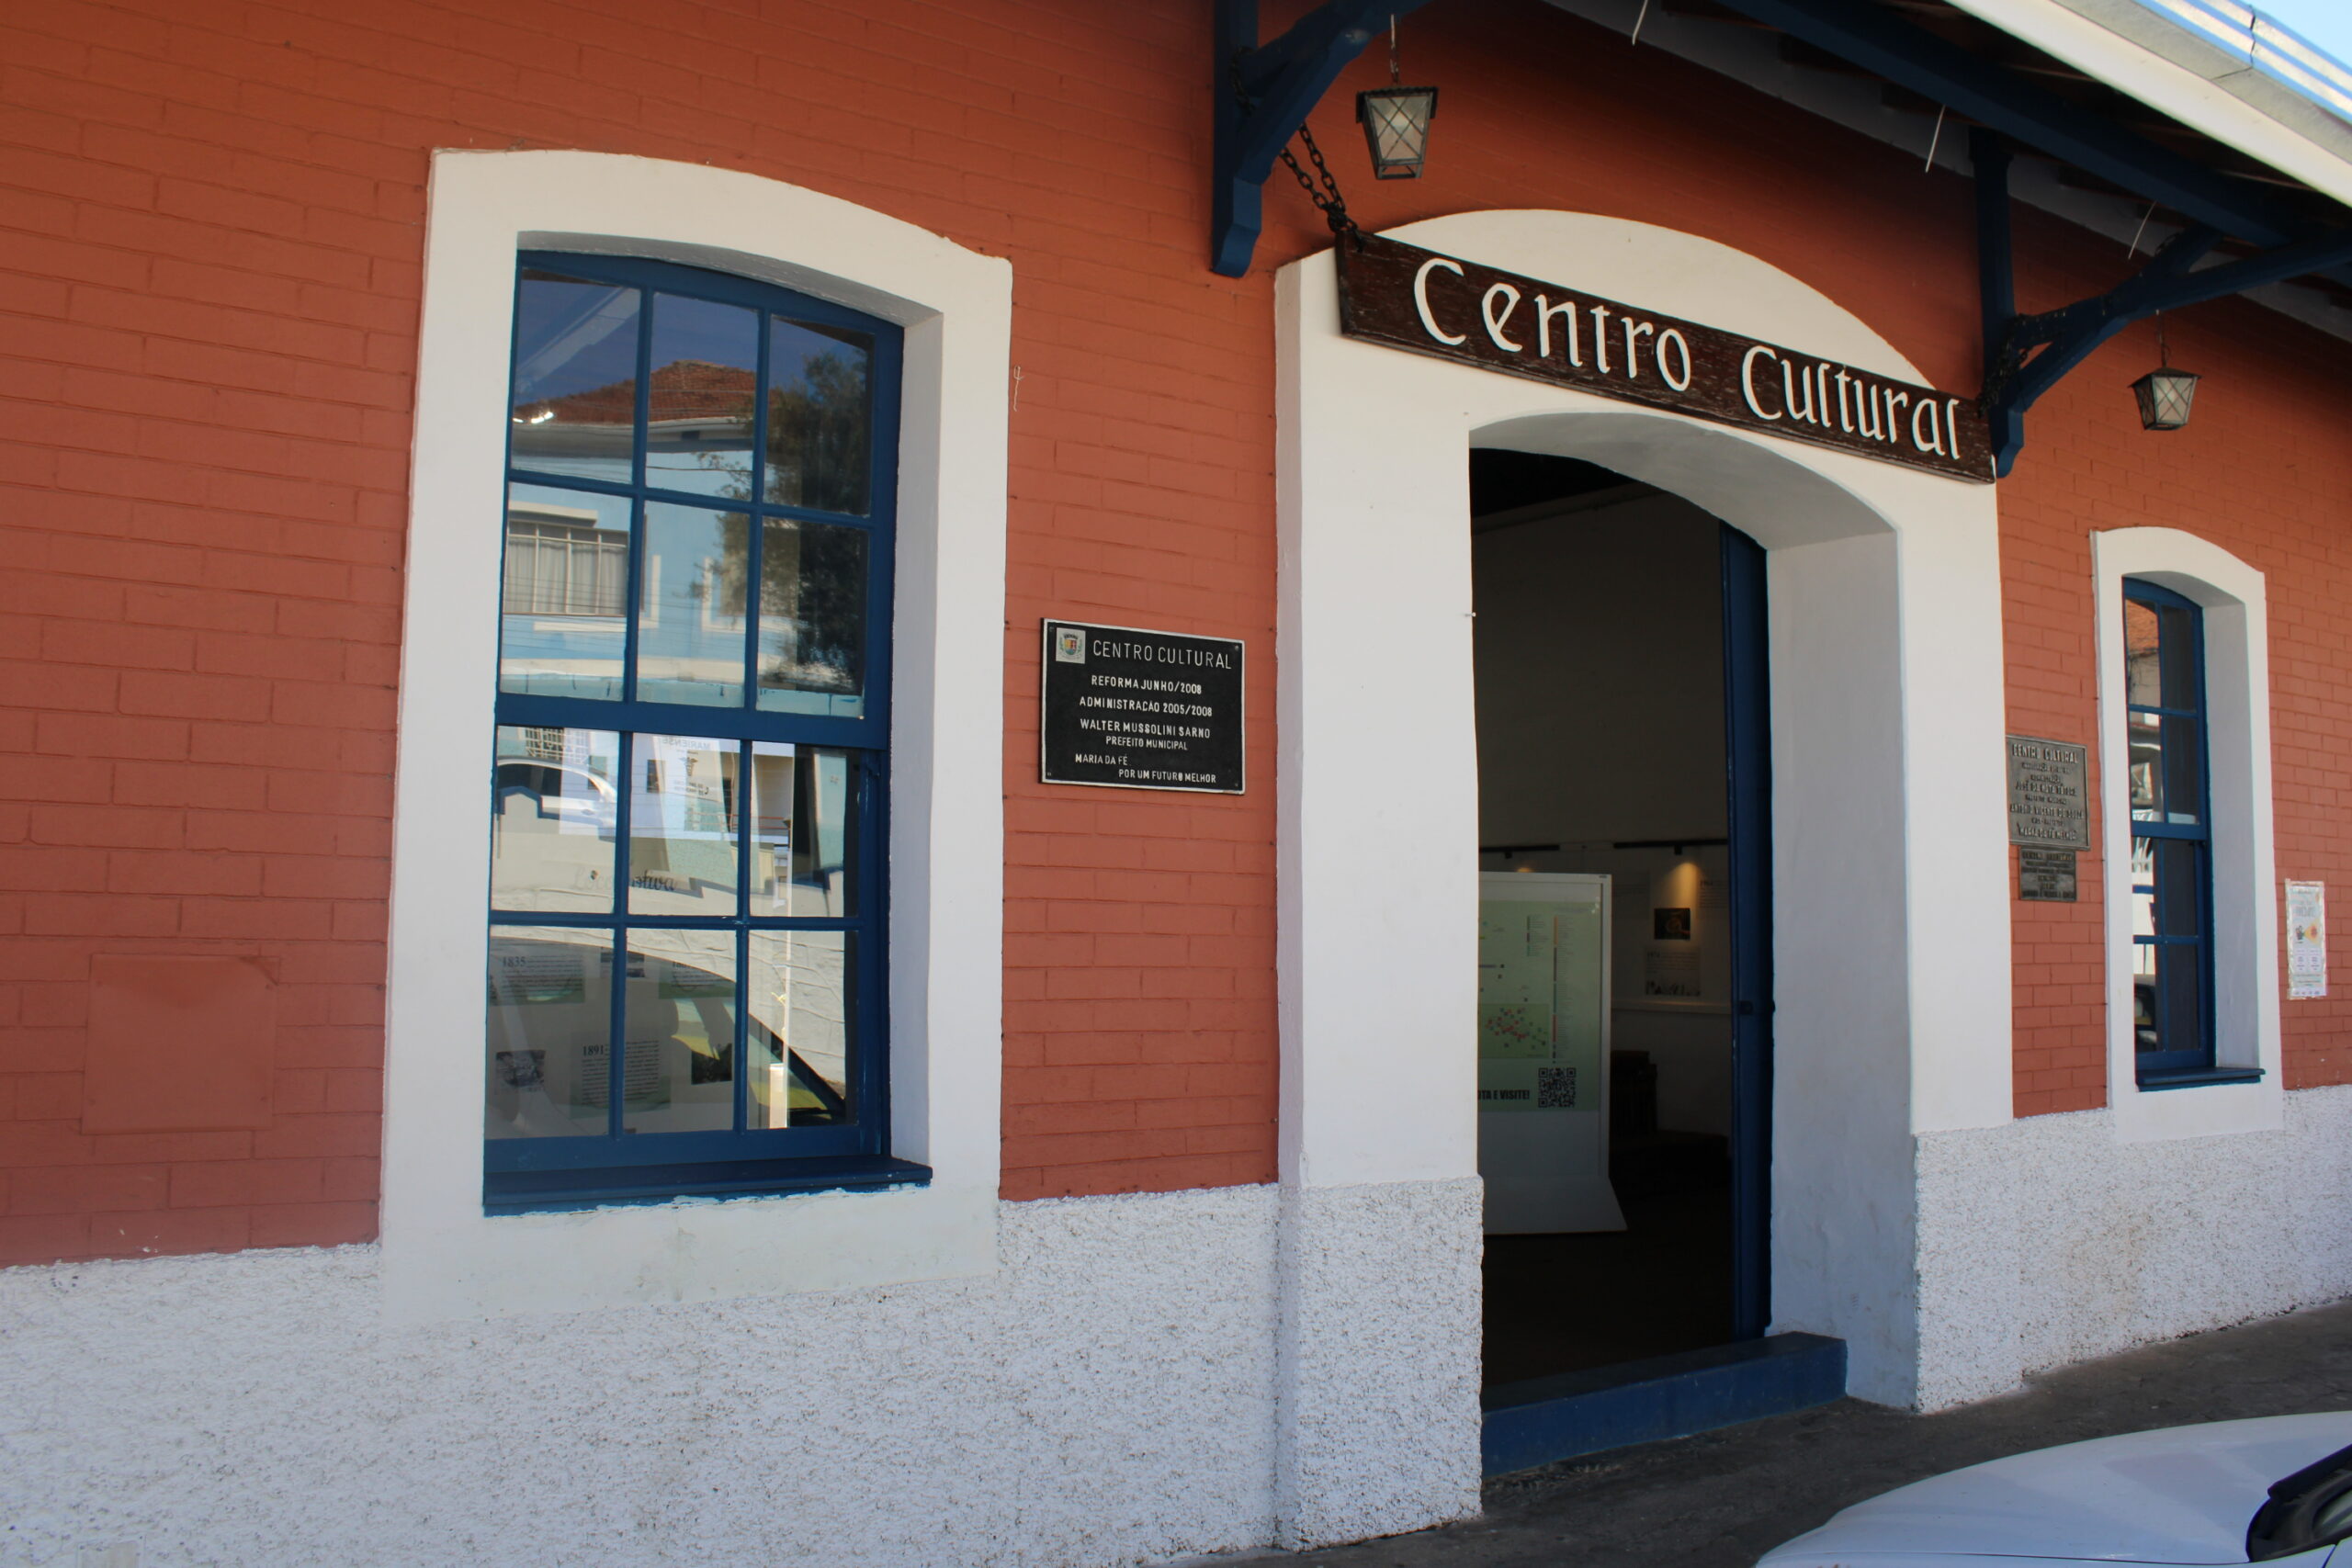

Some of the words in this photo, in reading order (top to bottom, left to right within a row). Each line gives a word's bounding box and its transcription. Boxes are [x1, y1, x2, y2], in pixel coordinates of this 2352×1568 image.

[1414, 257, 1691, 391] Centro
[1742, 345, 1961, 459] Cultural
[1093, 640, 1152, 661] CENTRO
[1159, 647, 1232, 669] CULTURAL
[1091, 675, 1138, 688] REFORMA
[1141, 679, 1202, 694] JUNHO/2008
[1163, 703, 1212, 716] 2005/2008
[1080, 718, 1120, 732] WALTER
[1124, 722, 1176, 736] MUSSOLINI
[1179, 727, 1210, 739] SARNO
[1106, 736, 1144, 747] PREFEITO
[1146, 739, 1188, 750] MUNICIPAL
[1076, 754, 1102, 763] MARIA
[1105, 755, 1115, 764] DA
[2012, 744, 2041, 760] CENTRO
[1119, 769, 1136, 778] POR
[1137, 770, 1149, 779] UM
[1152, 771, 1183, 781] FUTURO
[1185, 773, 1216, 784] MELHOR
[582, 1044, 605, 1056] 1891
[1499, 1089, 1530, 1100] VISITE!
